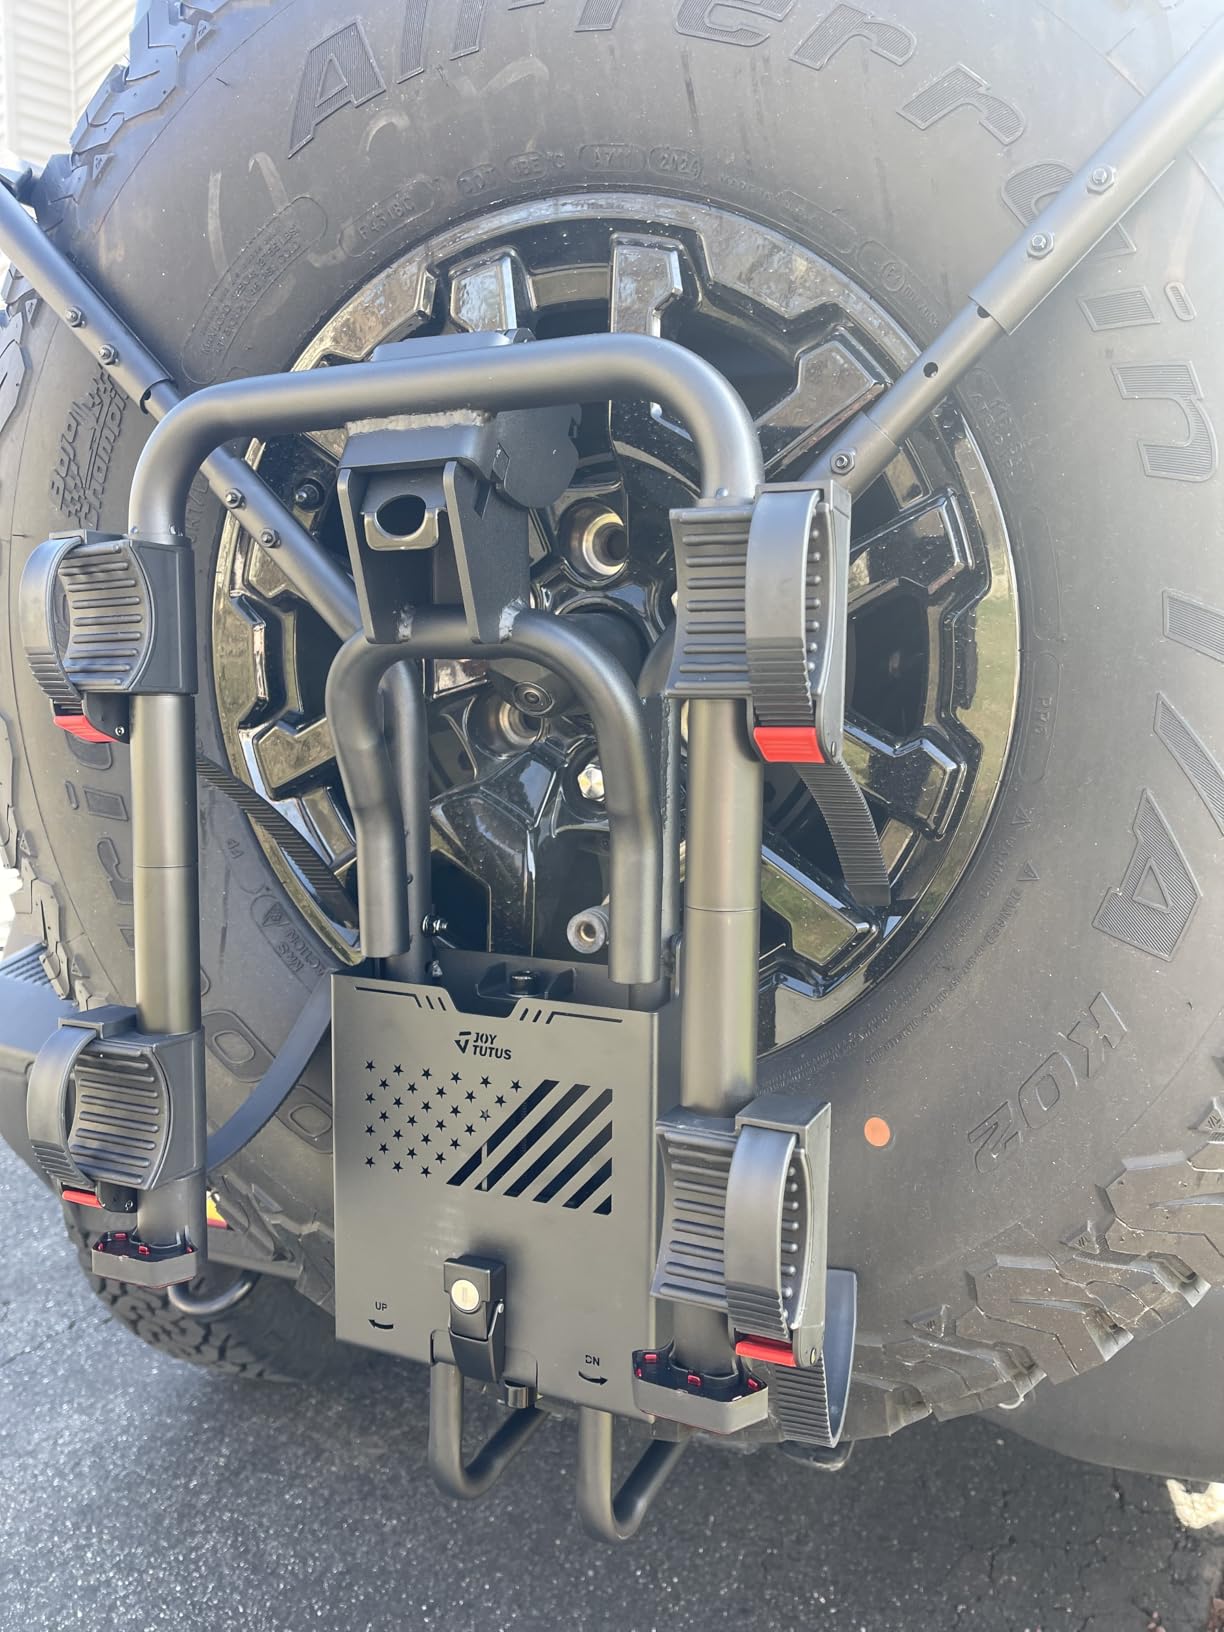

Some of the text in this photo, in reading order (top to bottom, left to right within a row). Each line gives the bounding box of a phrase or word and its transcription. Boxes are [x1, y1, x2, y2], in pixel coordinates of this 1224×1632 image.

[80, 389, 129, 531] Champi
[474, 1031, 498, 1046] JOY
[472, 1043, 512, 1061] TUTUS
[375, 1301, 389, 1313] UP
[584, 1353, 601, 1368] DN
